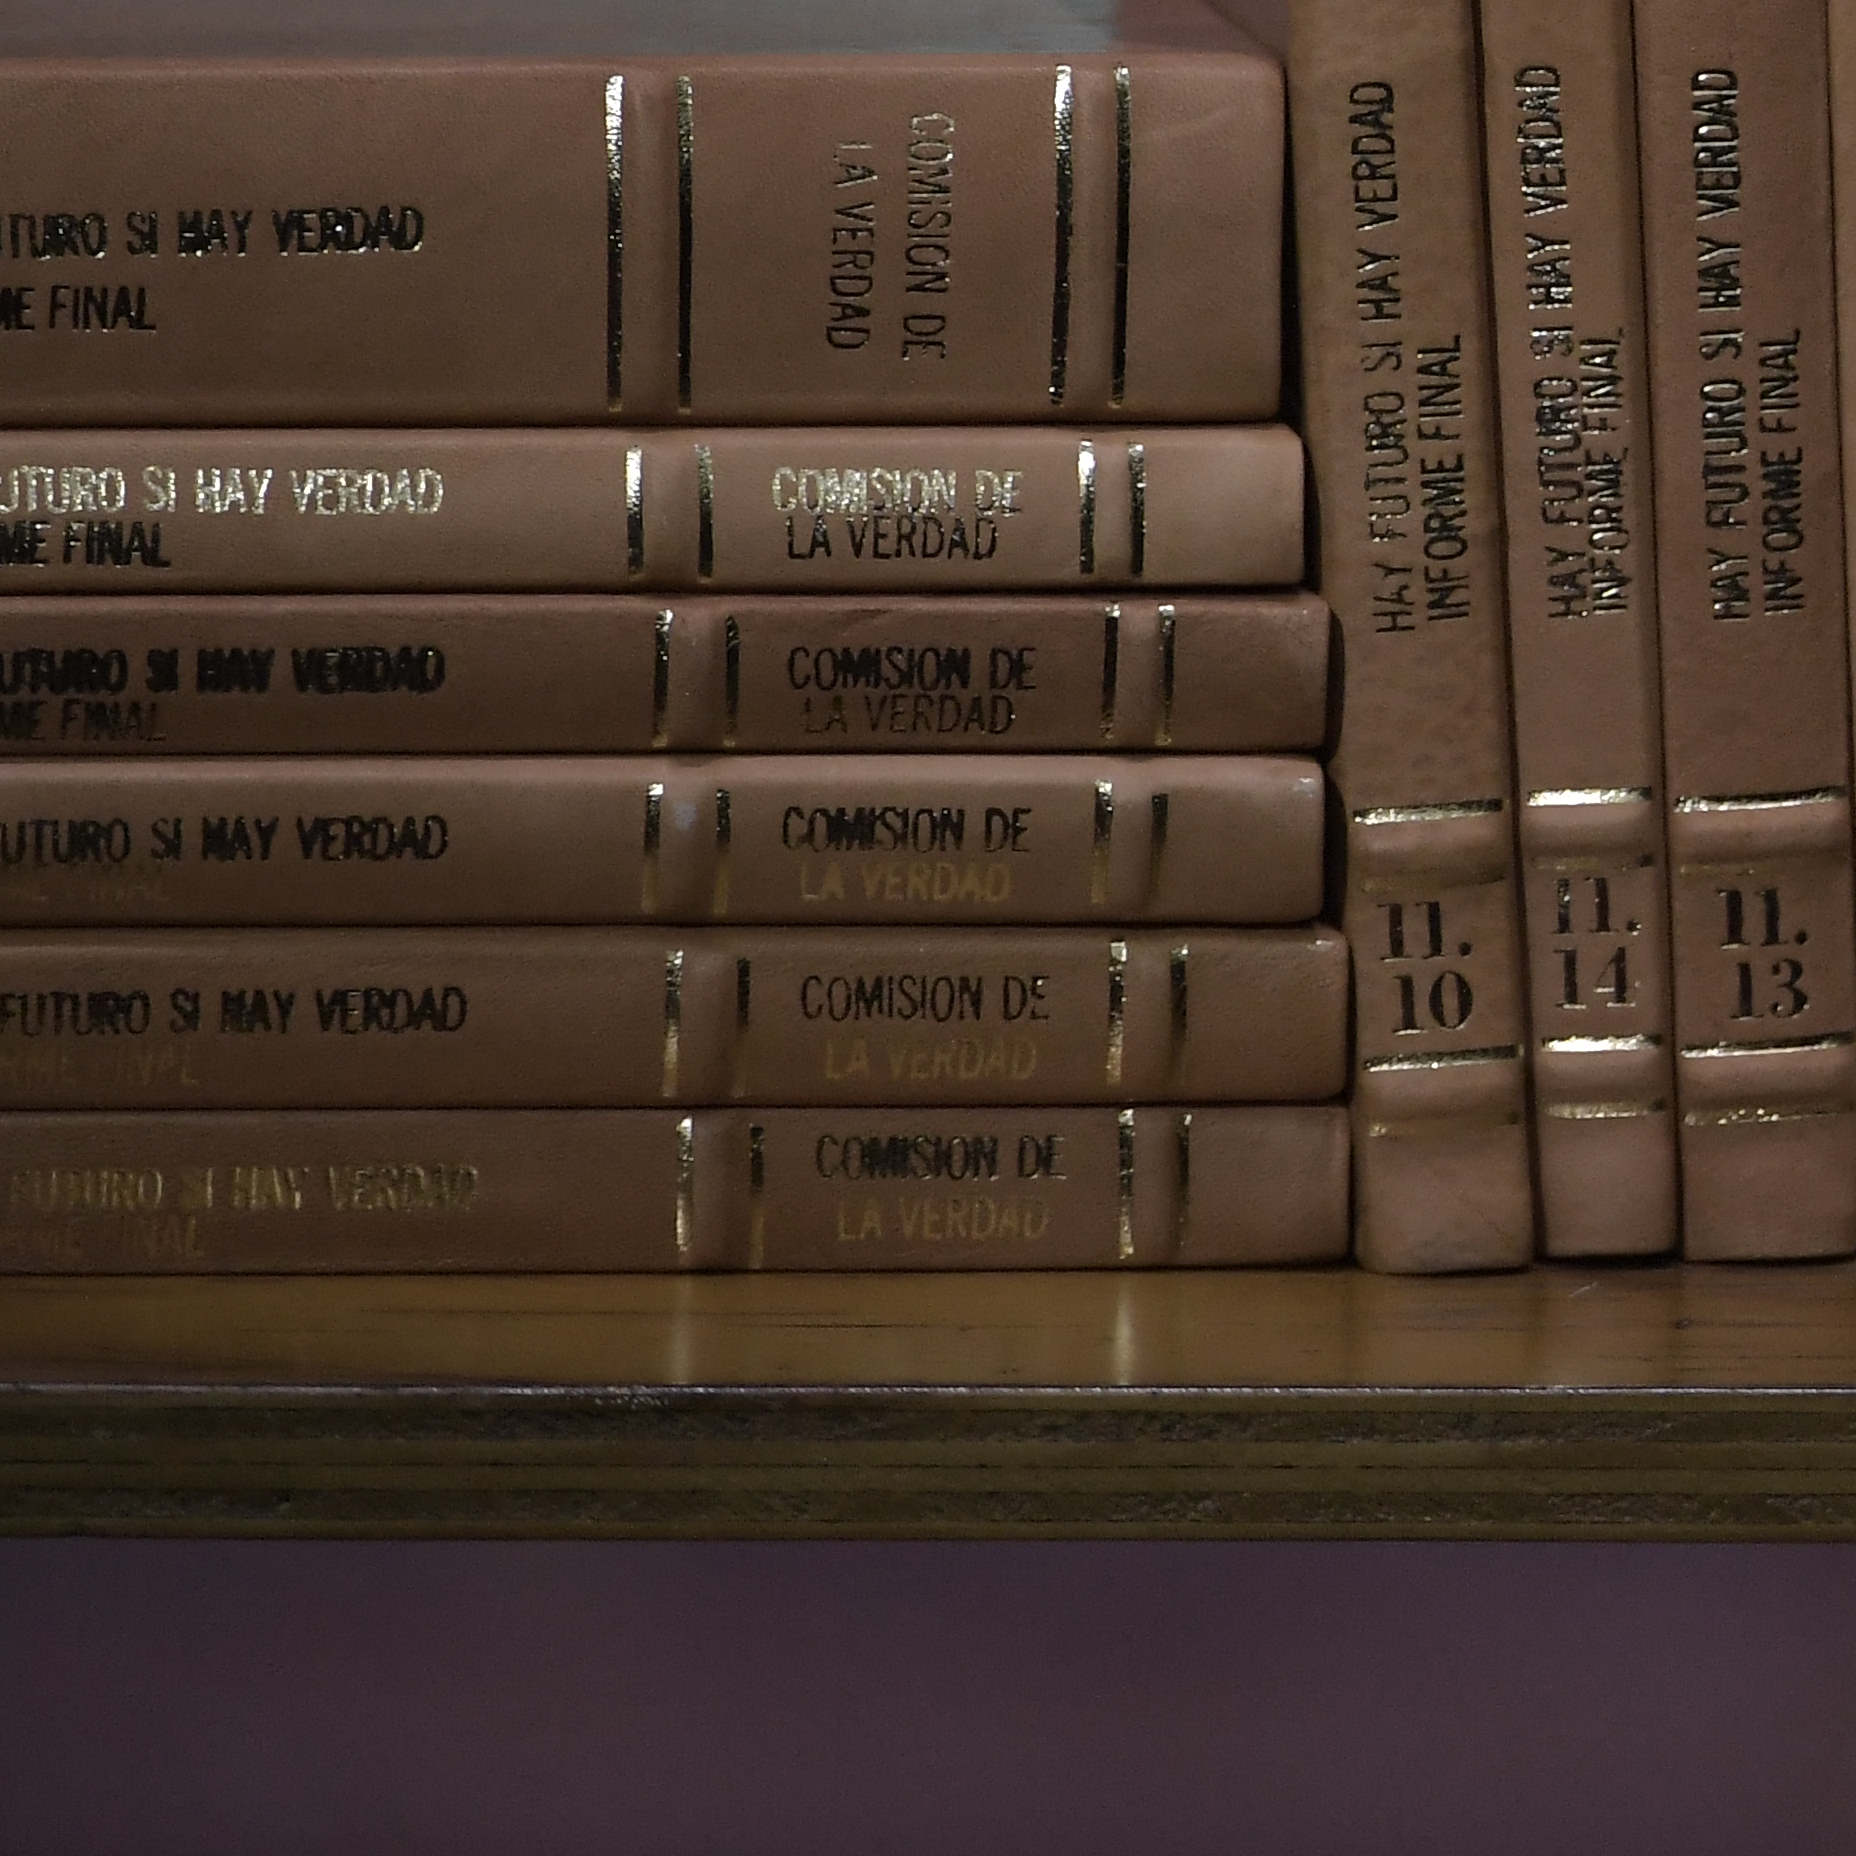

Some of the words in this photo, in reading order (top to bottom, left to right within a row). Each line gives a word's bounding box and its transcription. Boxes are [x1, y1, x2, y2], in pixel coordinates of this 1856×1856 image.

[832, 141, 877, 188] LA
[1349, 80, 1400, 232] VERDAD
[904, 112, 954, 296] COMISION
[127, 210, 157, 259] SI
[178, 208, 253, 259] HAY
[272, 206, 424, 255] VERDAD
[826, 202, 876, 351] VERDAD
[1356, 247, 1400, 322] HAY
[50, 286, 156, 333] FINAL
[901, 312, 947, 362] DE
[1361, 342, 1403, 373] SI
[1416, 334, 1462, 443] FINAL
[142, 467, 176, 514] SI
[196, 468, 273, 516] HAY
[290, 468, 444, 516] VERDAD
[771, 466, 957, 515] COMISION
[975, 469, 1022, 517] DE
[1364, 390, 1413, 543] FUTURO
[63, 522, 171, 568] FINAL
[785, 515, 831, 560] LA
[845, 515, 999, 560] VERDAD
[1420, 451, 1470, 622] INFORME
[1372, 561, 1415, 633] HAY
[786, 645, 971, 692] COMISION
[990, 645, 1037, 692] DE
[804, 694, 846, 735] LA
[862, 693, 1016, 735] VERDAD
[782, 806, 965, 853] COMISION
[983, 806, 1031, 853] DE
[1377, 900, 1473, 961] 11.
[1553, 877, 1643, 935] 11.
[1716, 887, 1809, 950] 11.
[800, 973, 984, 1024] COMISION
[1002, 975, 1051, 1021] DE
[1393, 970, 1474, 1036] 10
[1553, 947, 1638, 1010] 14
[1731, 958, 1809, 1020] 13
[169, 988, 201, 1036] SI
[220, 988, 296, 1035] HAY
[316, 985, 468, 1034] VERDAD
[815, 1134, 999, 1180] COMISION
[1017, 1135, 1067, 1181] DE
